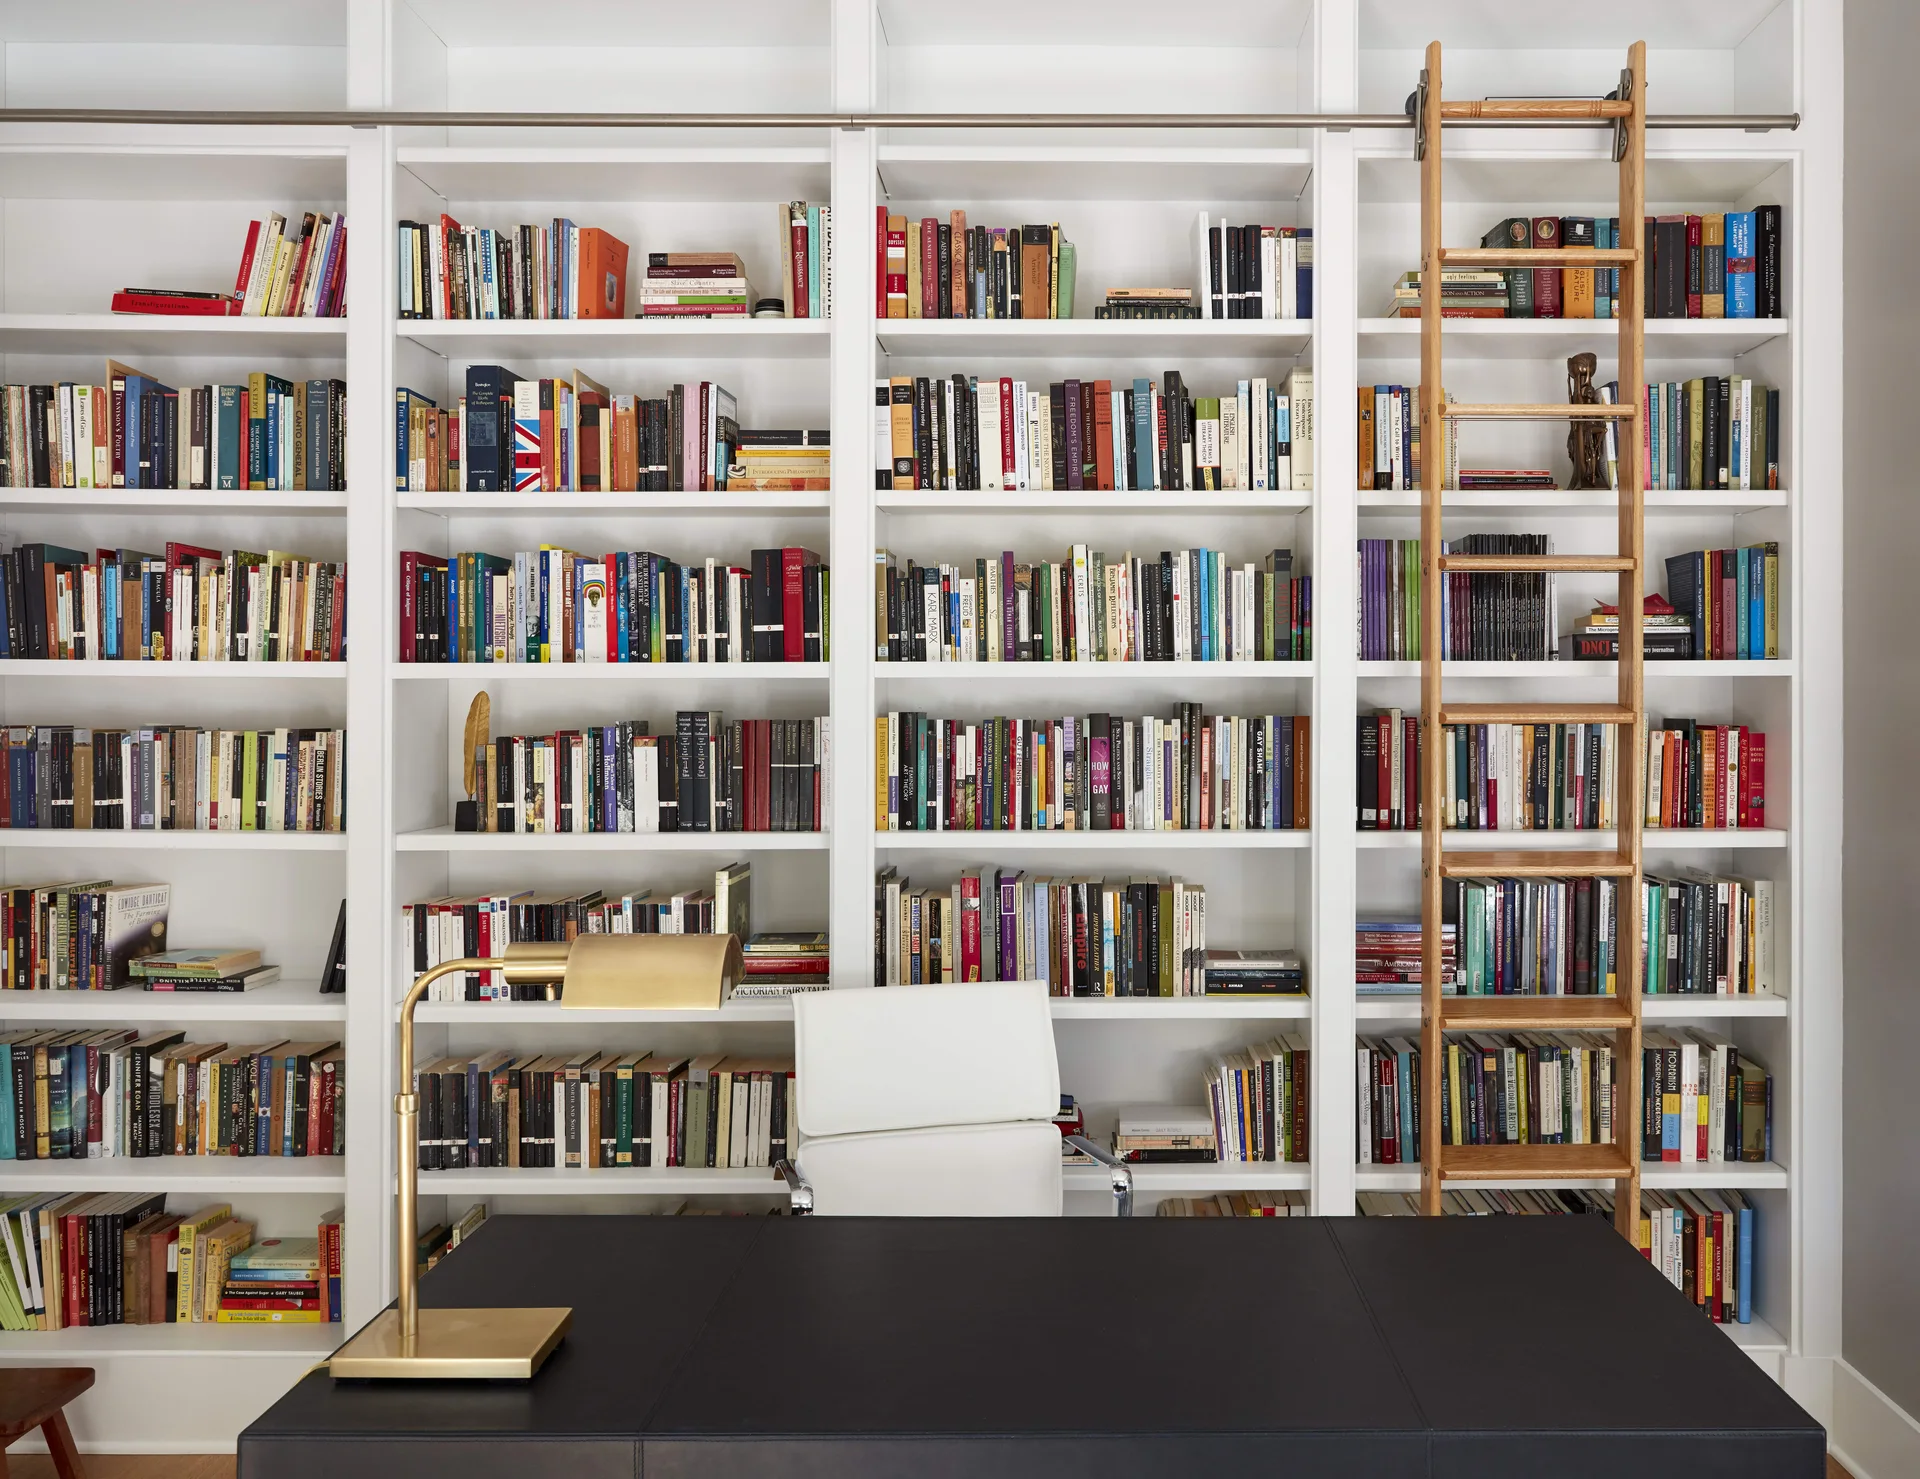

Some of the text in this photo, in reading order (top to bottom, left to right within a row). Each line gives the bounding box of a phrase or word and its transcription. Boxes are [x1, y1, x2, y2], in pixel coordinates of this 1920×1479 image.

[954, 231, 962, 266] CLASSICAL
[131, 300, 190, 310] Transfigurations
[1158, 409, 1167, 451] EAGLETON
[927, 592, 938, 644] KARL MARX
[1109, 596, 1117, 629] REFLECTIONS
[494, 614, 506, 647] NIETZSCHE
[1581, 640, 1610, 656] DNCJ
[315, 751, 325, 800] BERLIN STORIES
[1092, 762, 1108, 770] HOW
[1144, 747, 1153, 780] Straight
[1092, 785, 1108, 794] GAY
[1719, 784, 1724, 793] ON
[1074, 913, 1087, 969] Empire
[736, 986, 780, 996] VICTORIAN
[783, 986, 806, 995] FAIRY
[1668, 1051, 1677, 1091] MODERNISM
[149, 1086, 160, 1128] MIDDLESEX
[181, 1257, 190, 1310] LORD PETER
